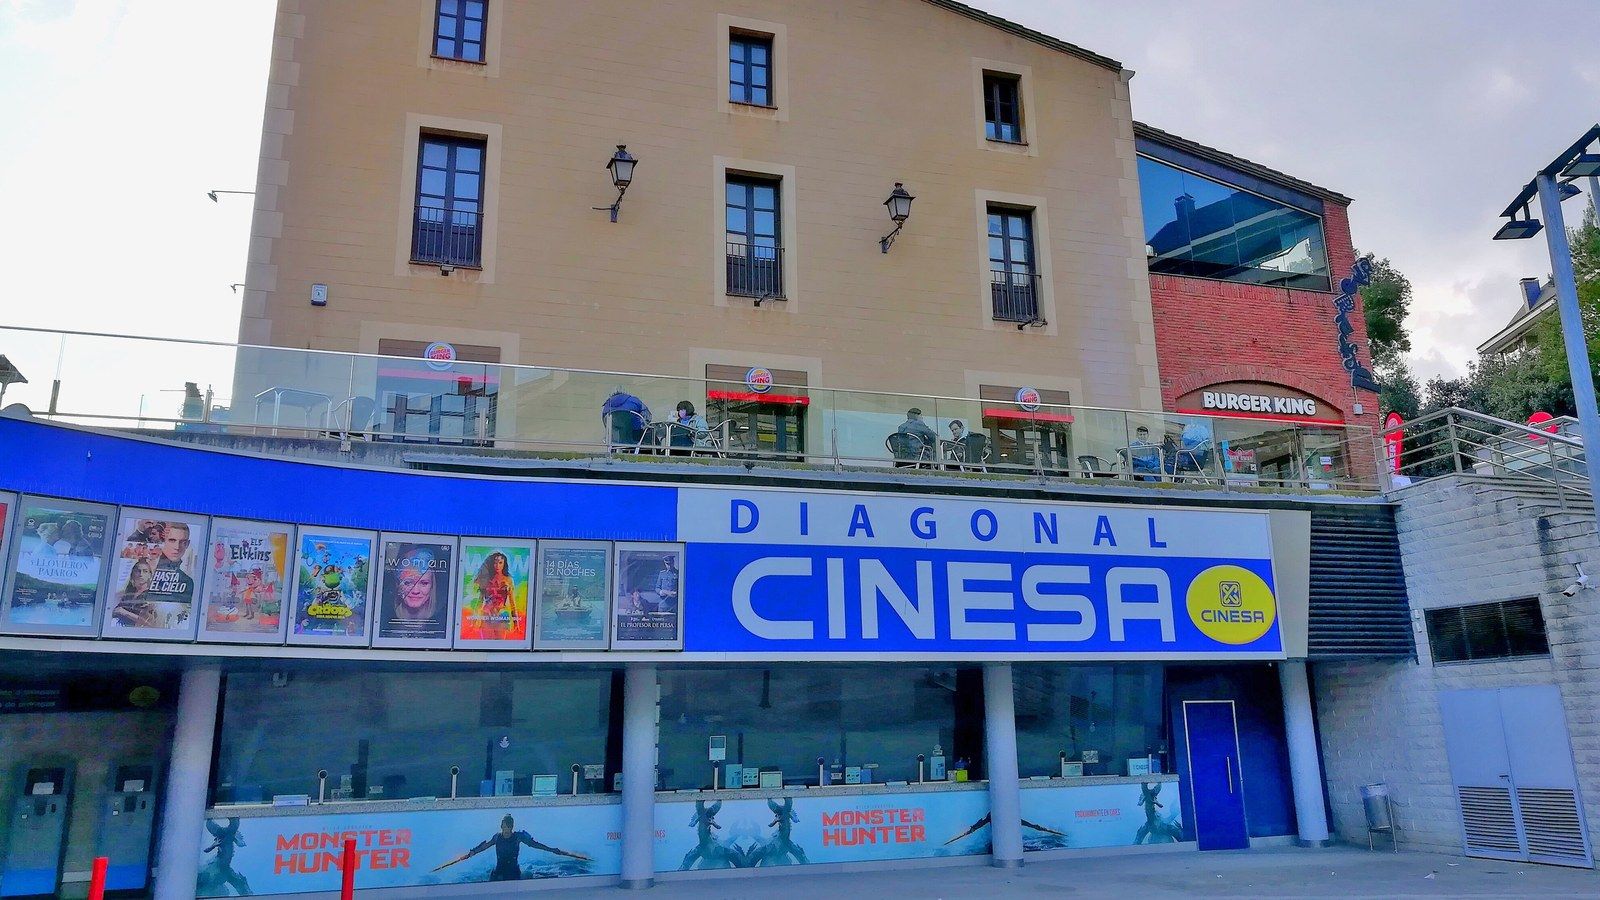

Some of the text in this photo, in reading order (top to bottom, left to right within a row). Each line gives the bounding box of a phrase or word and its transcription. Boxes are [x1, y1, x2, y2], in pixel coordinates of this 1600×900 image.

[1203, 391, 1316, 415] BURGER KING
[731, 499, 1167, 548] DIAGONAL
[250, 538, 263, 546] ELS
[230, 544, 271, 561] Elfkins
[388, 558, 447, 568] woman
[545, 560, 555, 569] 14
[153, 570, 180, 582] HASTA
[545, 568, 596, 577] 12 NOCHES
[149, 580, 187, 593] EL CIELO
[732, 556, 1176, 642] CINESA
[1201, 609, 1264, 623] CINESA
[822, 808, 925, 827] MONSTER
[276, 829, 411, 850] MONSTER
[822, 825, 926, 847] HUNTER
[274, 848, 410, 875] HUNTER
